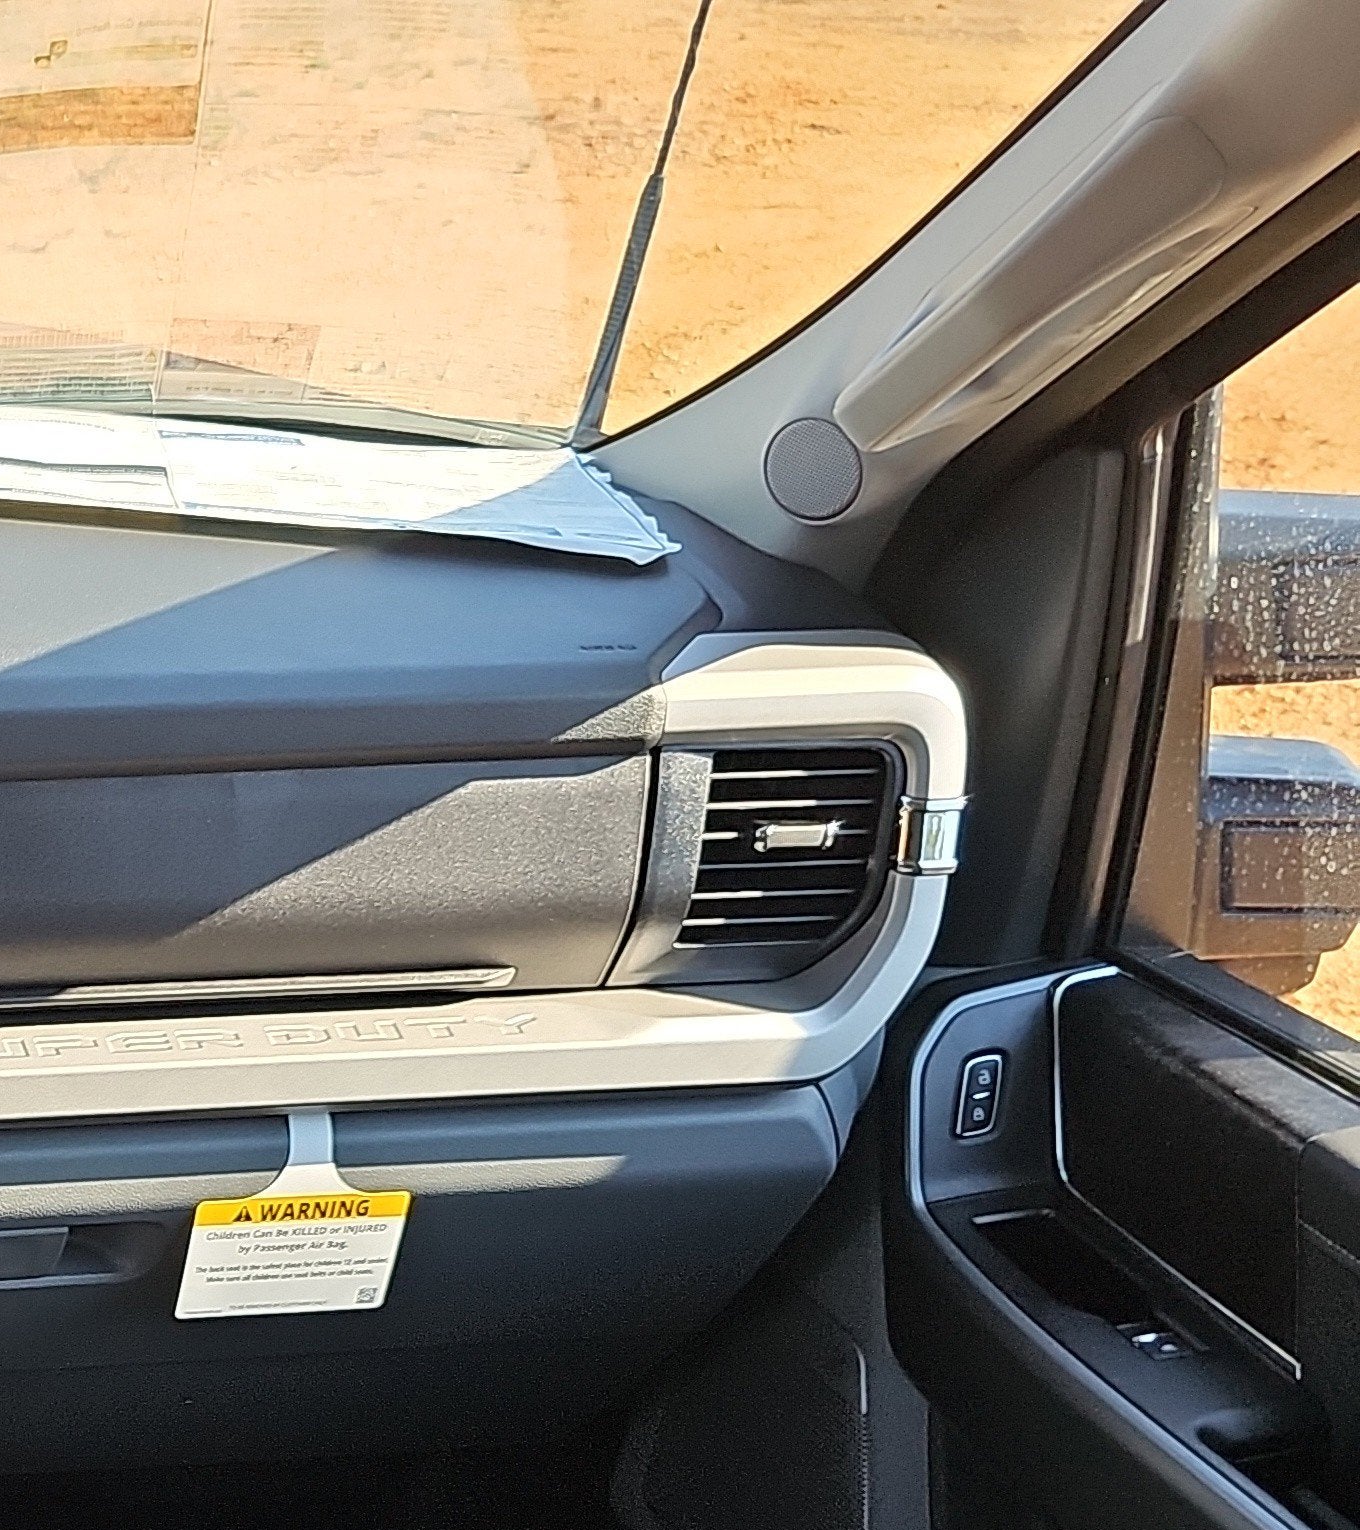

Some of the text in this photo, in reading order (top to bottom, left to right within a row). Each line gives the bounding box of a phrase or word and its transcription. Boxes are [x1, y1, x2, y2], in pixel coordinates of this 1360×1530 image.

[263, 1012, 536, 1046] DUTY
[260, 1200, 370, 1222] WARNING
[206, 1231, 250, 1241] Children
[253, 1229, 273, 1238] Can
[276, 1229, 288, 1237] Be
[292, 1227, 327, 1236] KILLED
[343, 1224, 387, 1234] INJURED
[238, 1245, 251, 1255] by
[253, 1243, 307, 1253] Passenger
